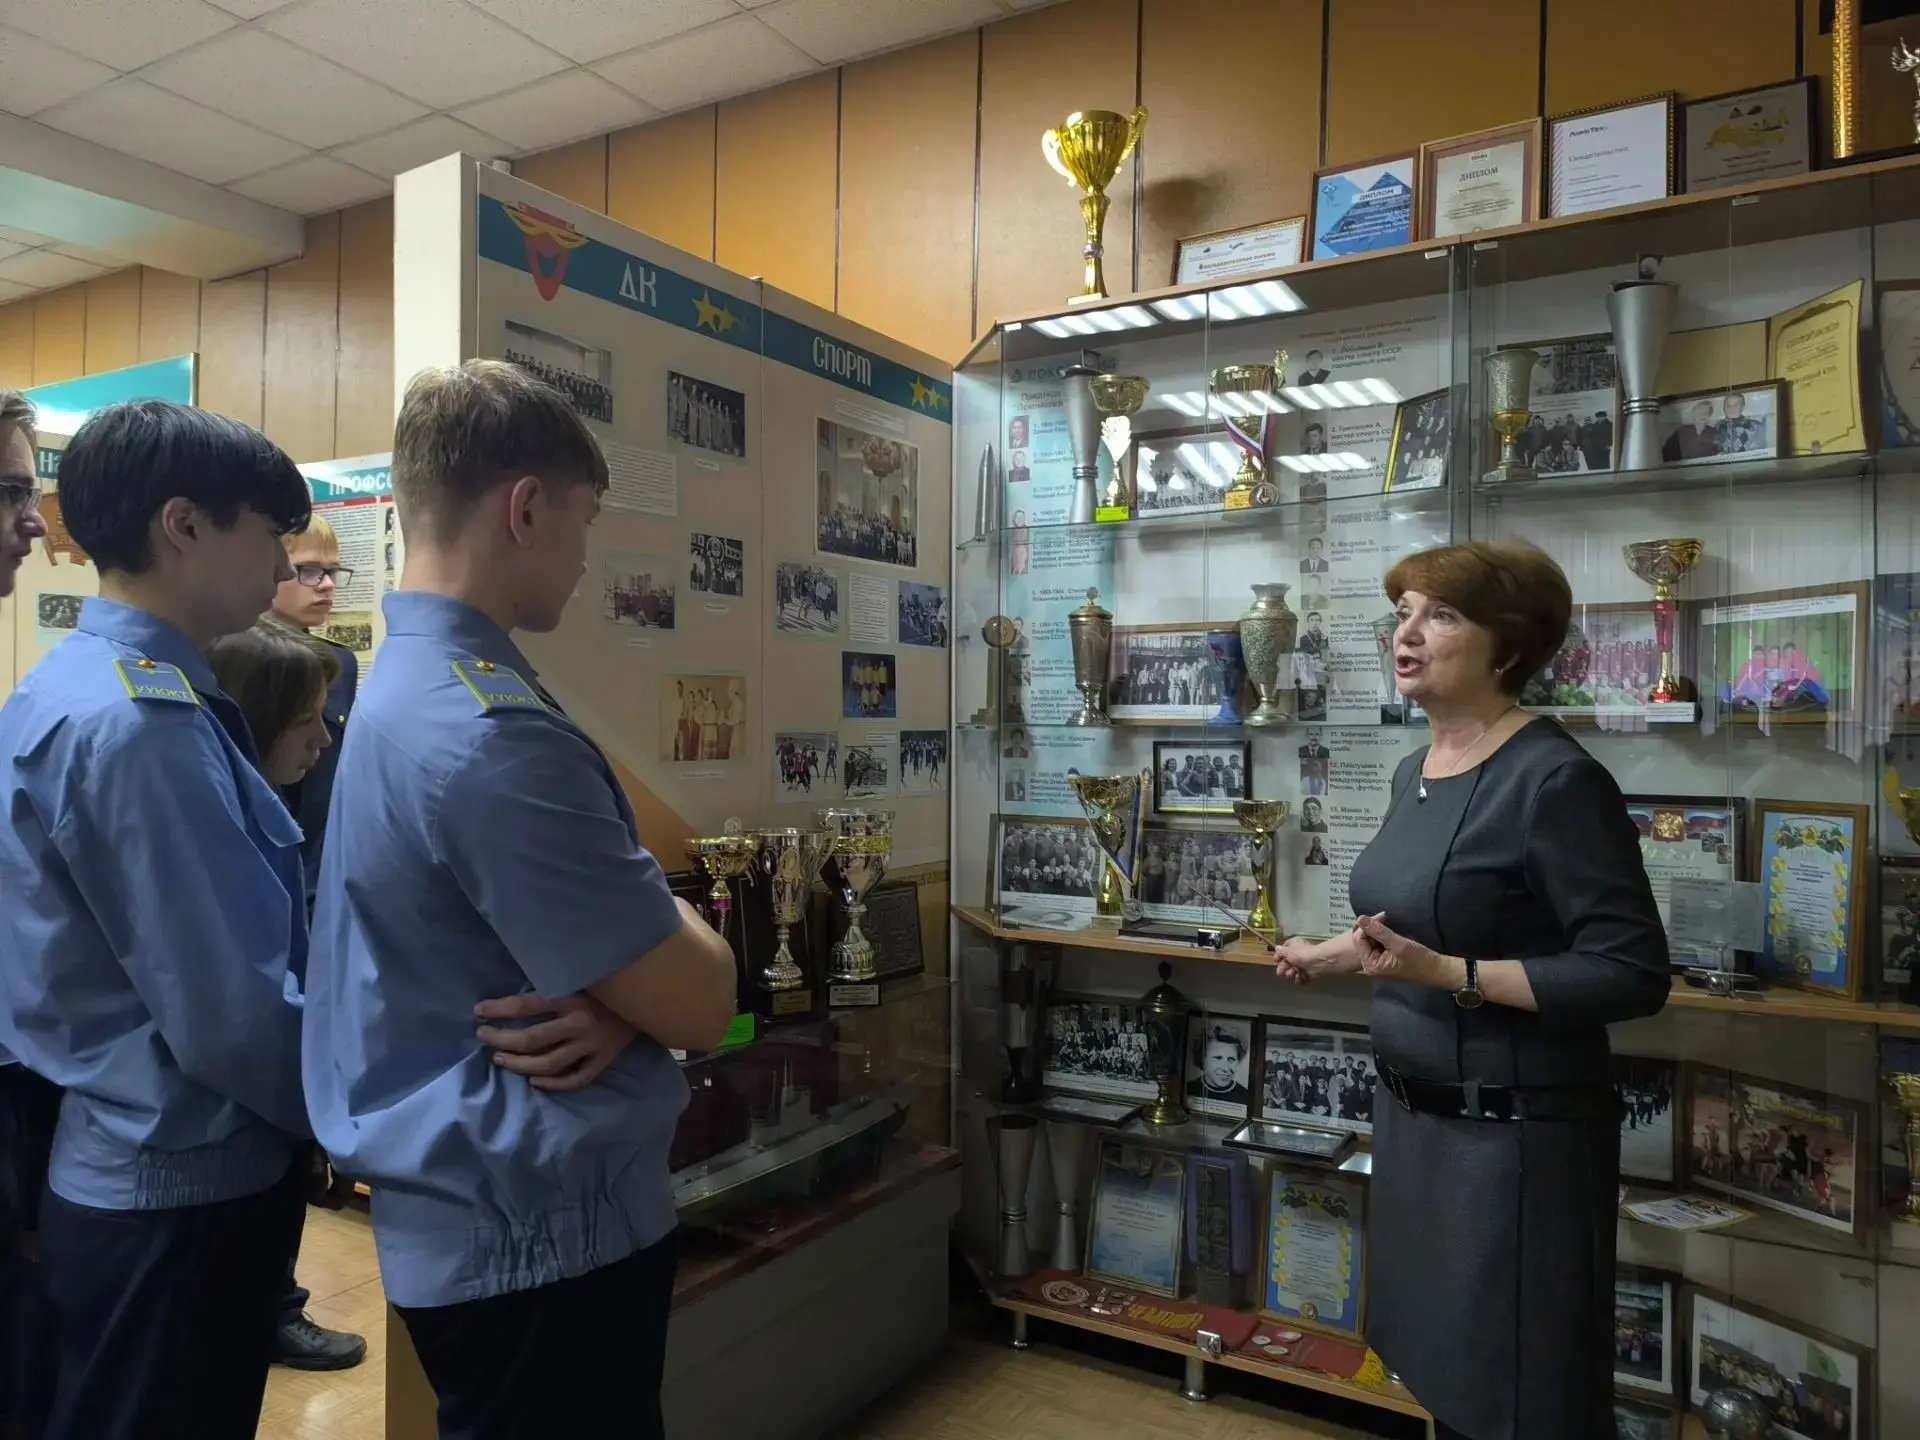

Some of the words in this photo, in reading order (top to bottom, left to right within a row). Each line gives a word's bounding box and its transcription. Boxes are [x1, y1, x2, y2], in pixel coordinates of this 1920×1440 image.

[1459, 166, 1499, 182] ДИПЛОМ
[1360, 188, 1394, 201] ДИПЛОМ
[618, 260, 657, 308] ДК
[812, 335, 873, 387] СПОРТ
[136, 685, 190, 700] УУКЖТ
